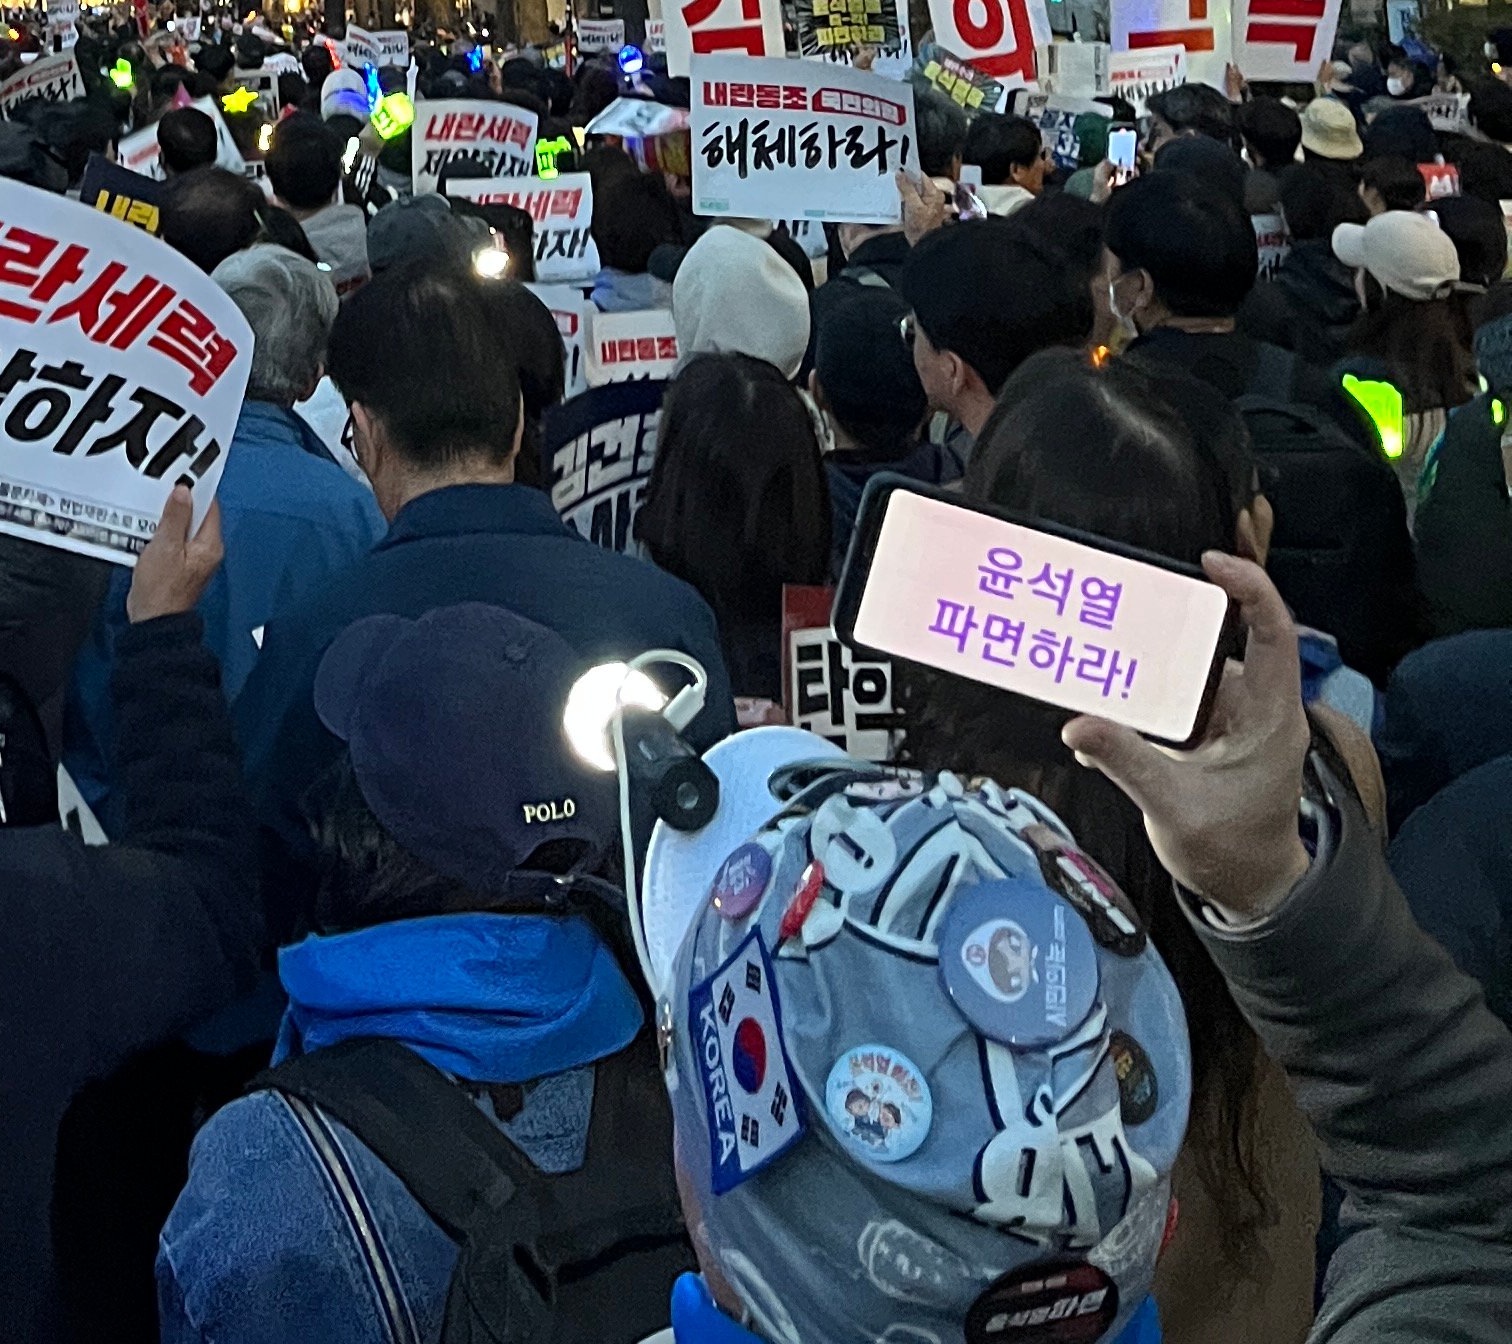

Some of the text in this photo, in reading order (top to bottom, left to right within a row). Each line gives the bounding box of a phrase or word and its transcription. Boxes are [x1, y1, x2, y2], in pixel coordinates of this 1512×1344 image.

[702, 81, 899, 124] 내란동조 국민의힘
[424, 112, 533, 152] 내란세력
[701, 117, 910, 180] 해체하라!
[601, 337, 678, 365] 내란동조
[977, 546, 1123, 631] 윤석열
[928, 597, 1139, 700] 파면하라!
[523, 798, 576, 824] POLO
[699, 1003, 737, 1166] KOREA
